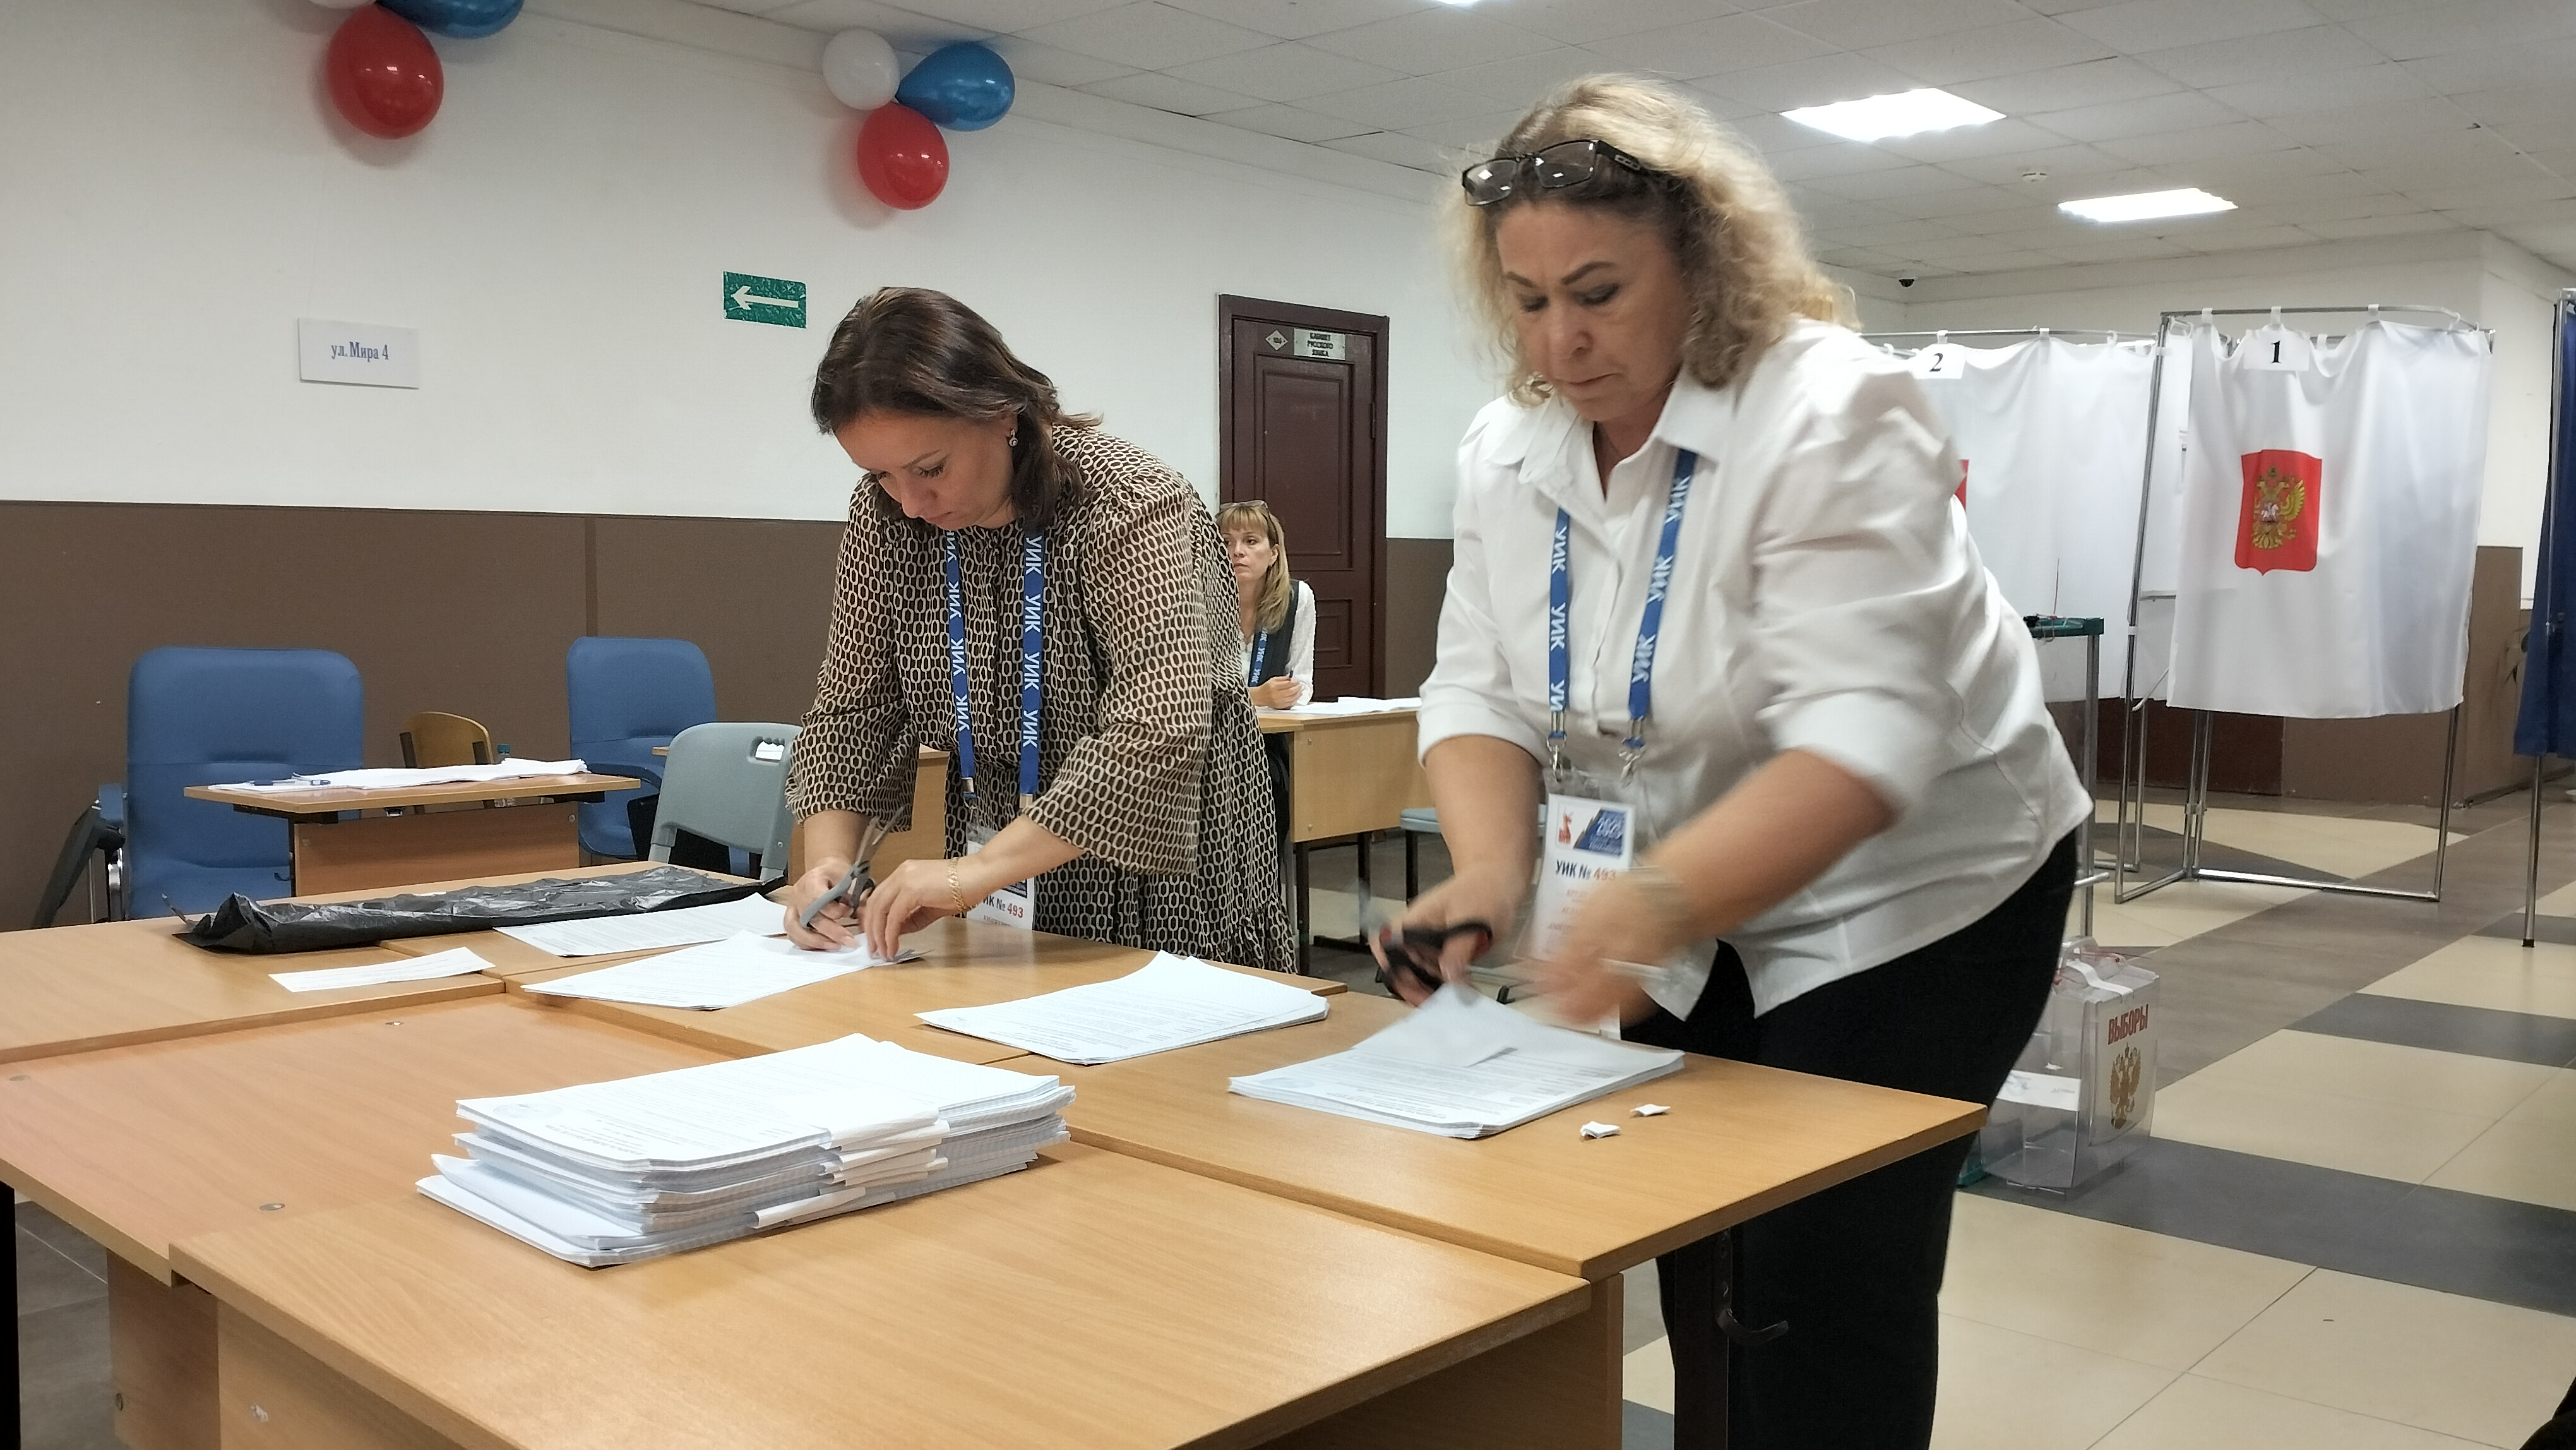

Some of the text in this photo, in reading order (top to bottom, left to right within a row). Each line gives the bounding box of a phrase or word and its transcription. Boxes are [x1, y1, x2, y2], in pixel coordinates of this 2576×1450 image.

[331, 341, 389, 362] ул. Мира 4
[1929, 352, 1943, 373] 2
[2270, 340, 2281, 364] 1
[948, 580, 962, 620] УИК
[1550, 525, 1567, 711] УИК УИК УИ
[1022, 536, 1042, 748] УИК УИК УИК УИК
[950, 637, 966, 676] УИК
[1256, 647, 1265, 662] УИК
[1251, 668, 1261, 683] УИК
[956, 693, 970, 731] УИК
[1556, 860, 1577, 878] УИК
[1578, 865, 1592, 880] №
[983, 895, 1023, 918] ИК № 493
[2108, 1004, 2149, 1045] ВЫБОРЫ
